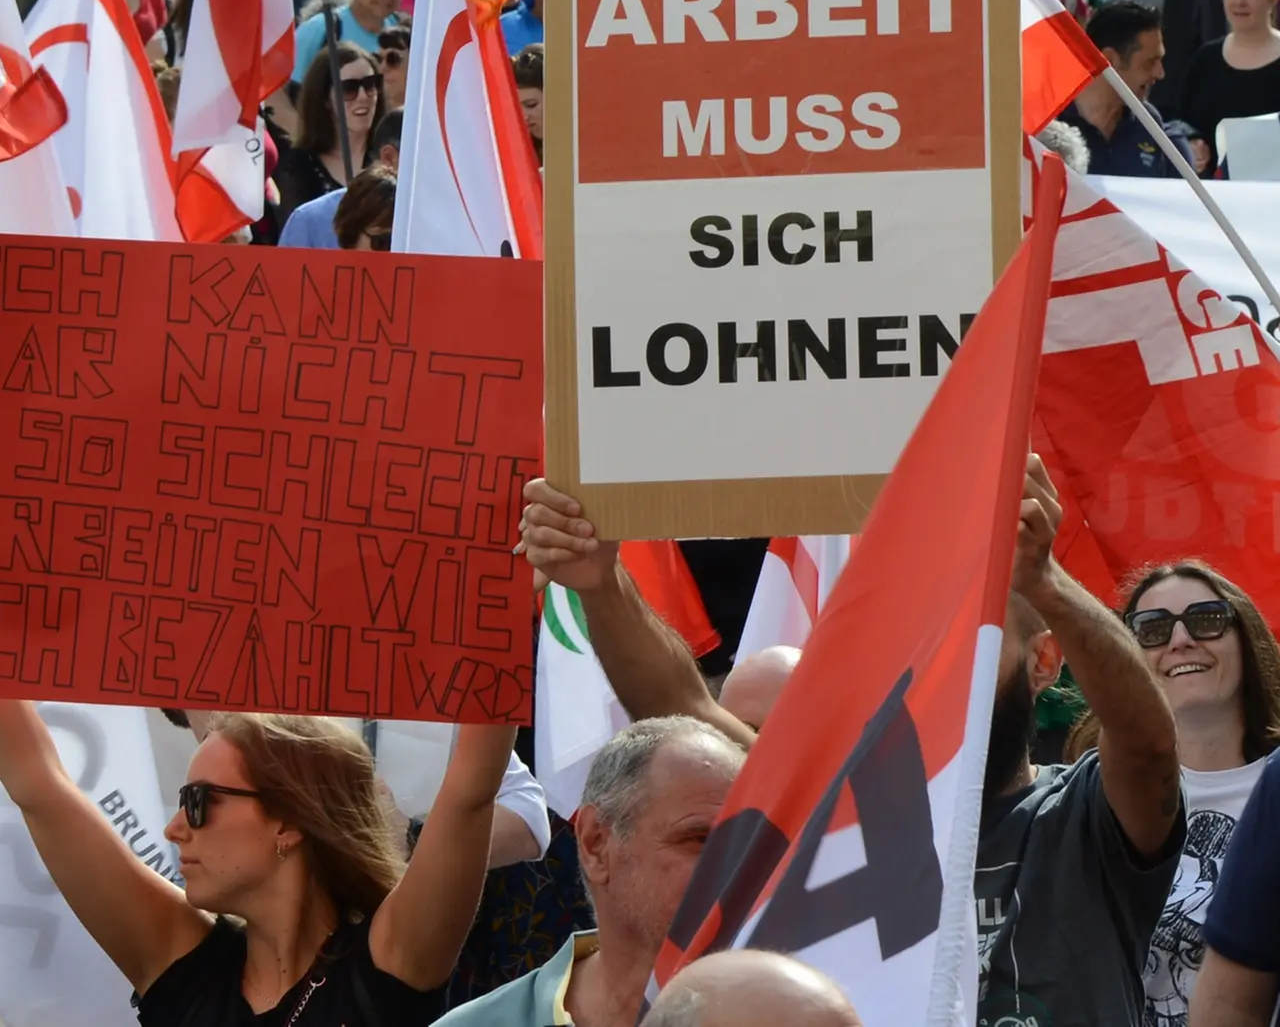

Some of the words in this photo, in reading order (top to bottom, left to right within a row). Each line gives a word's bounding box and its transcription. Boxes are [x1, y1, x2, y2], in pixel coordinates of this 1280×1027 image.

[662, 90, 901, 158] MUSS
[688, 208, 874, 269] SICH
[167, 254, 415, 347] KANN
[14, 407, 129, 491] SO
